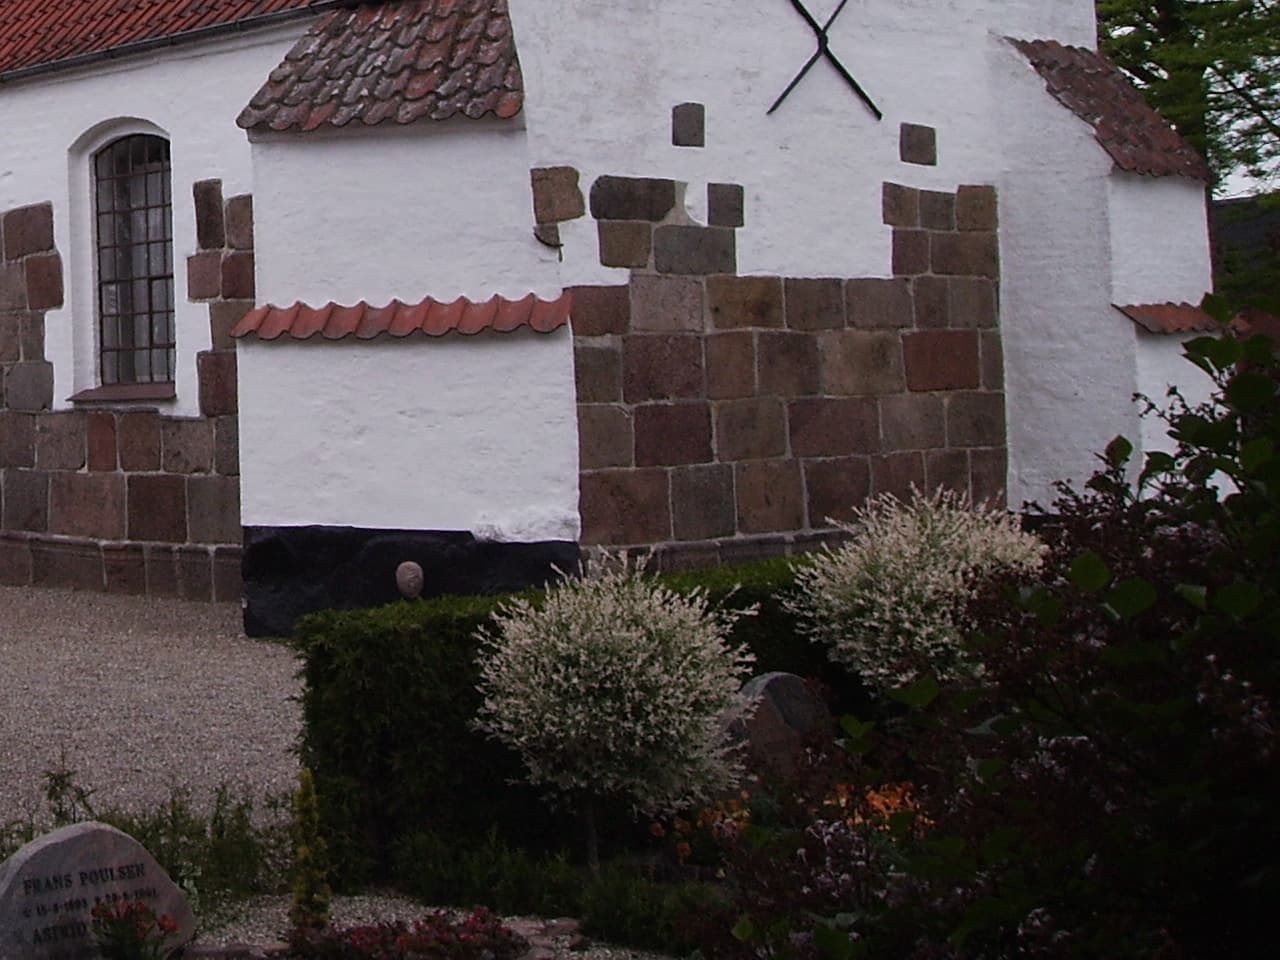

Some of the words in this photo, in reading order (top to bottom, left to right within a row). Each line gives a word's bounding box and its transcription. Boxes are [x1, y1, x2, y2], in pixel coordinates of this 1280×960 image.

[23, 873, 73, 895] FRANS
[79, 863, 146, 886] POULSEN
[33, 921, 87, 945] ASTRID
